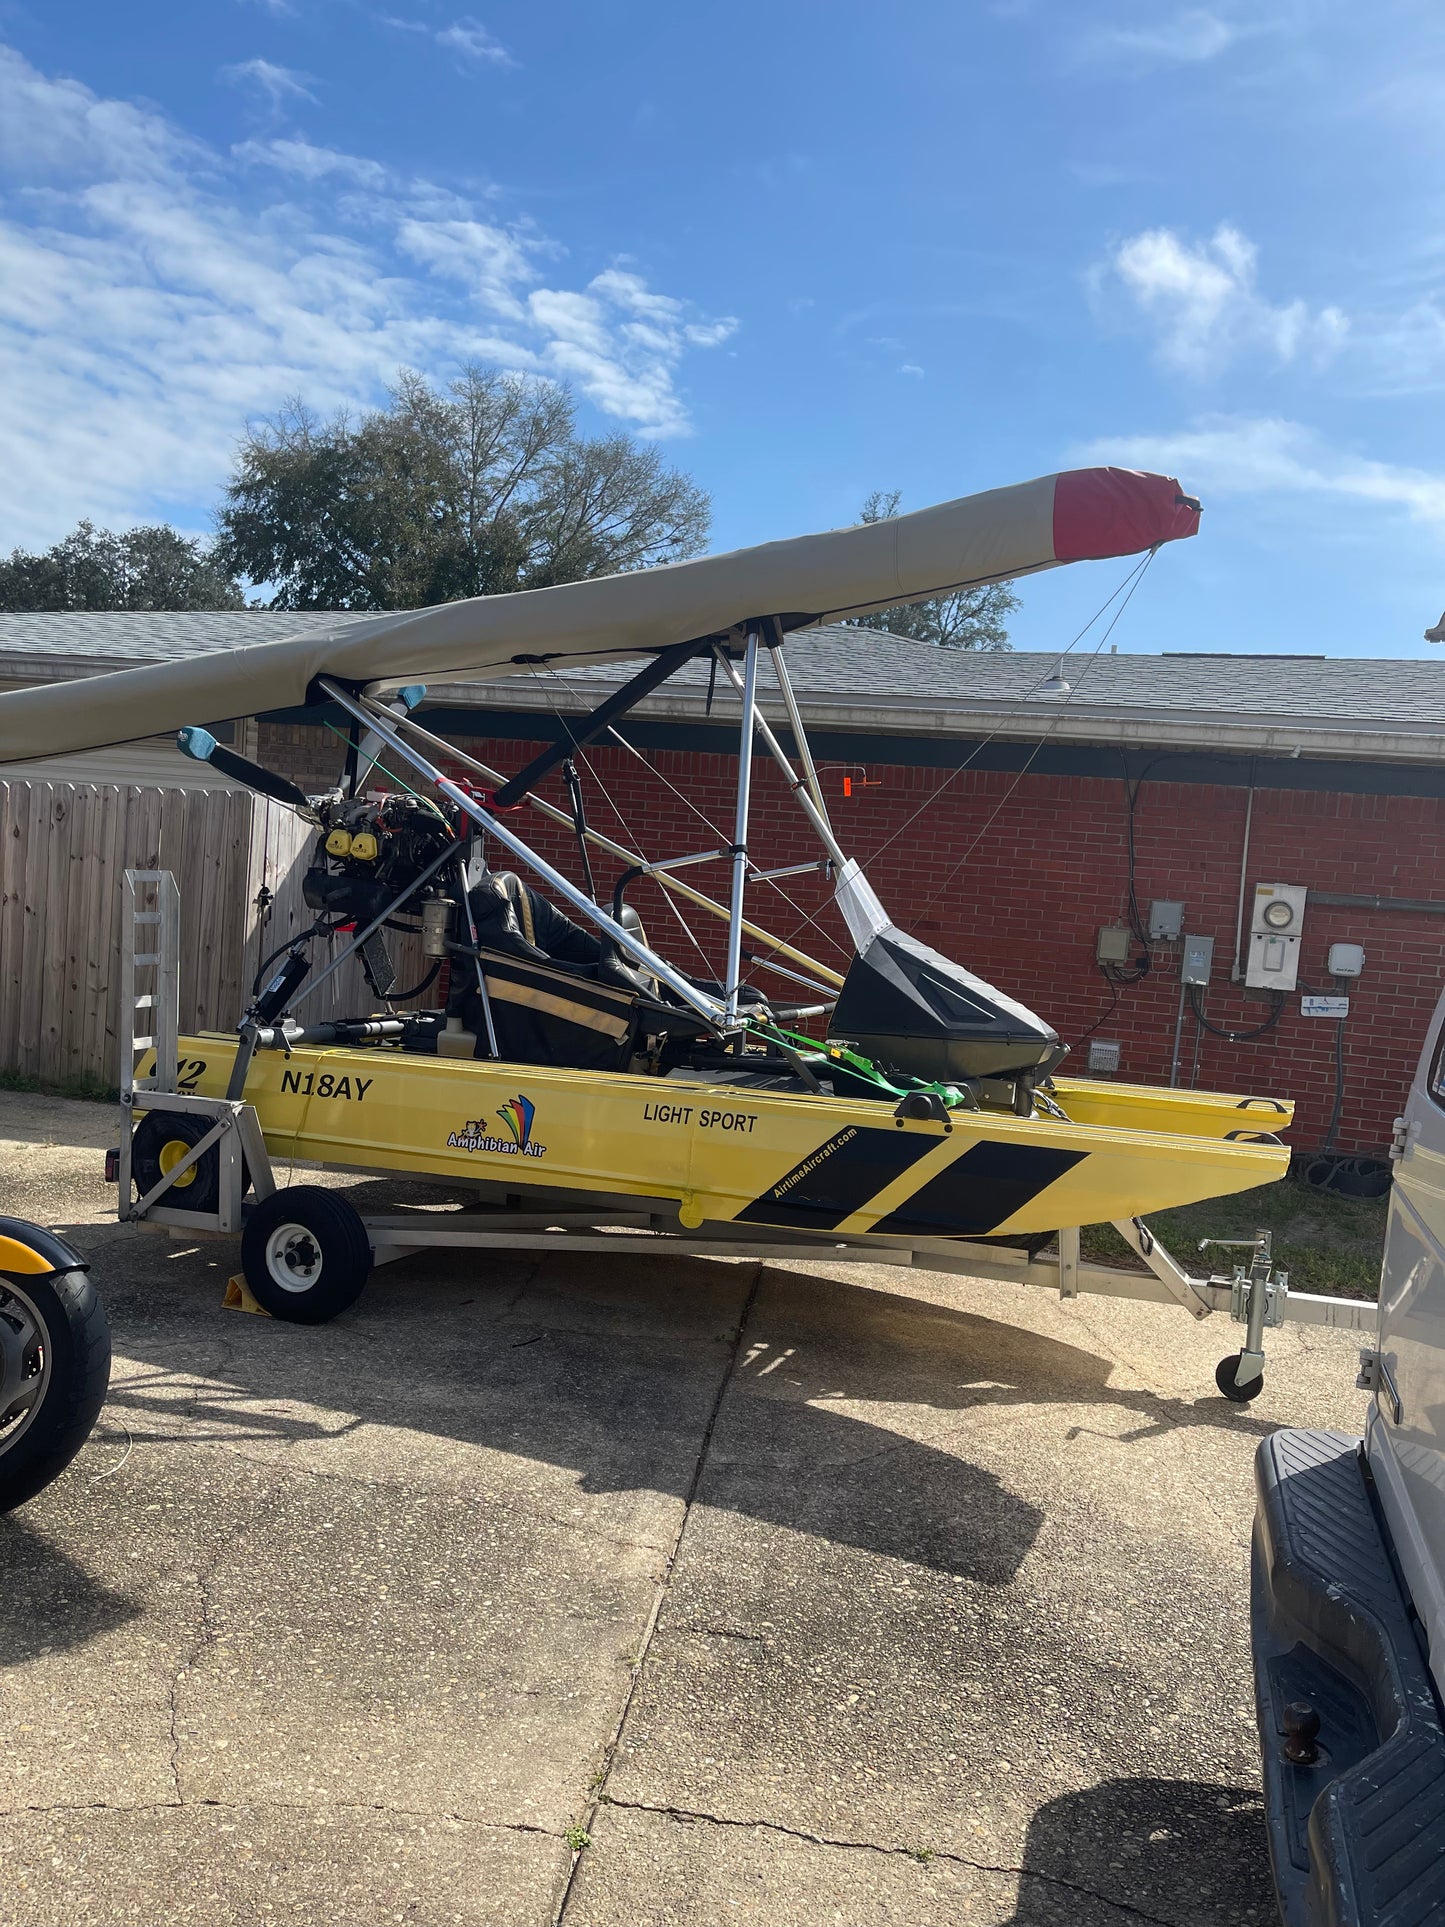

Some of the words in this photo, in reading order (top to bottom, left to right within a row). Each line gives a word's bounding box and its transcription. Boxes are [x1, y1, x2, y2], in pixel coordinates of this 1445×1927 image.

[280, 1070, 374, 1102] N18AY
[643, 1103, 694, 1125] LIGHT
[699, 1110, 758, 1133] SPORT
[447, 1131, 519, 1153] Amphibian
[522, 1141, 547, 1158] Air
[773, 1127, 858, 1199] AirtimeAircraft.com
